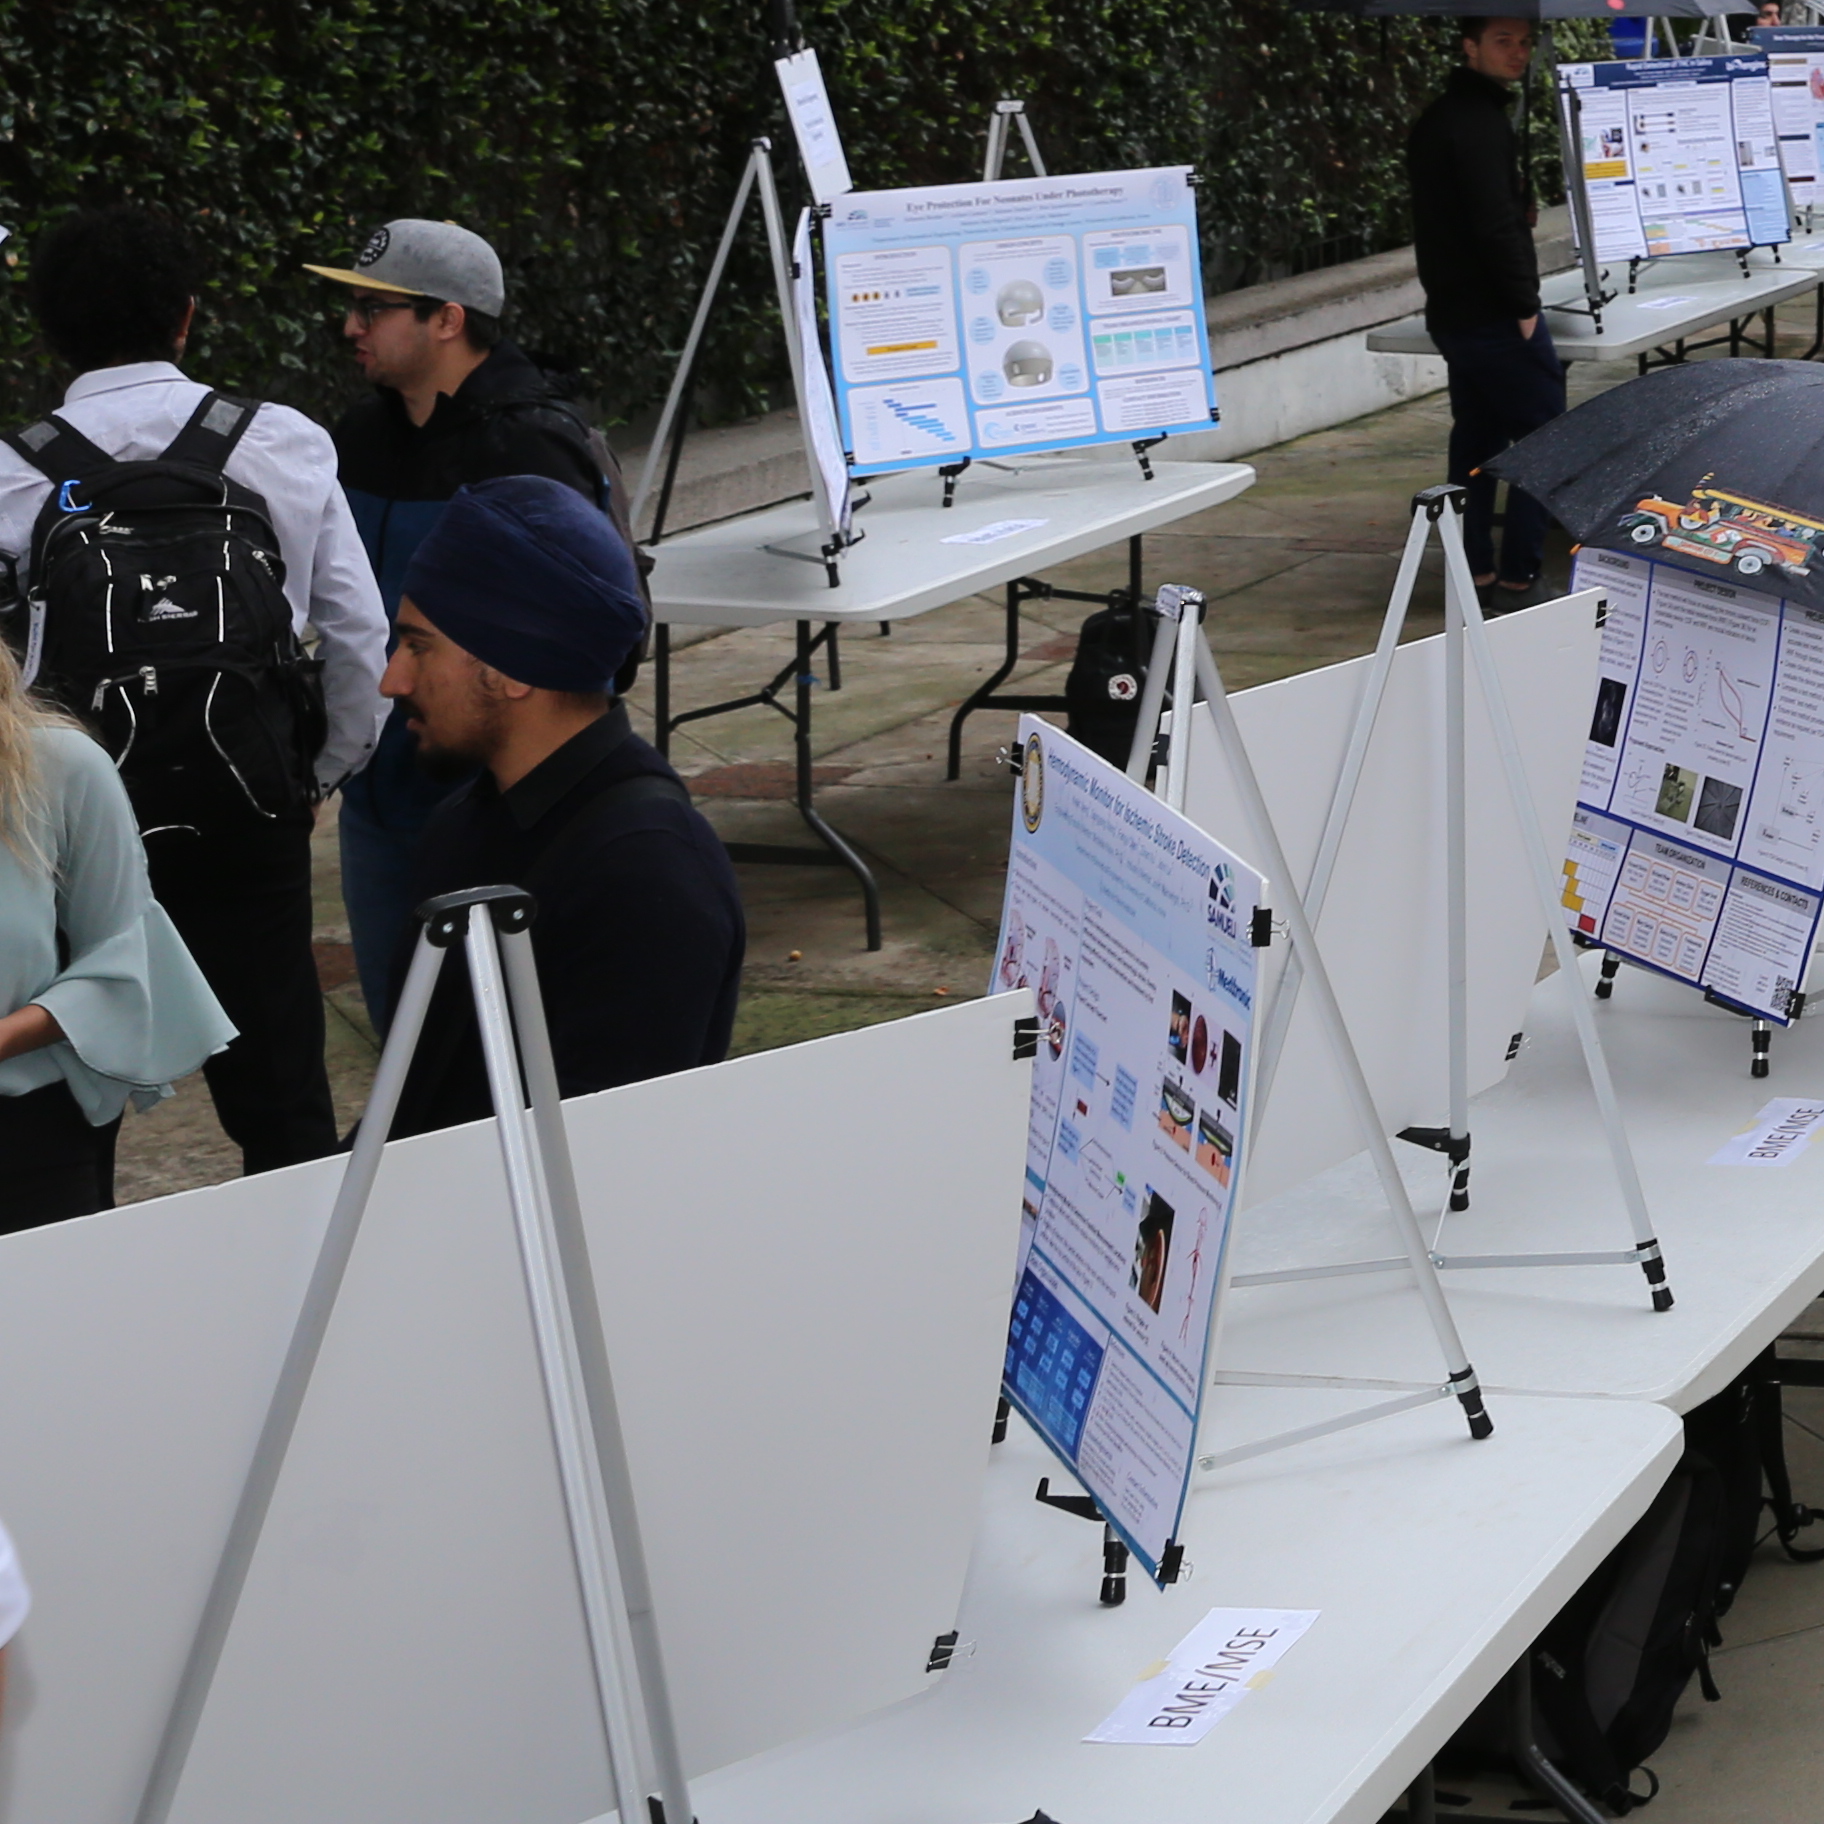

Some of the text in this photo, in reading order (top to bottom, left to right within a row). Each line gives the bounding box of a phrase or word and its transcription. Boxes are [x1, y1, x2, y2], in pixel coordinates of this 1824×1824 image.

[906, 184, 1124, 213] Eye Protection For Neonates Under Phototherapy
[1047, 747, 1211, 879] Hemodynamic Monitor for Ischemic Stroke Detection
[1669, 847, 1706, 871] ORGANIZATION
[1740, 875, 1775, 896] REFERENCES
[1780, 890, 1809, 911] CONTACTS
[1207, 904, 1237, 939] SAMUELI
[1217, 967, 1251, 1008] Medtronic
[1146, 1625, 1280, 1729] BME/MSE
